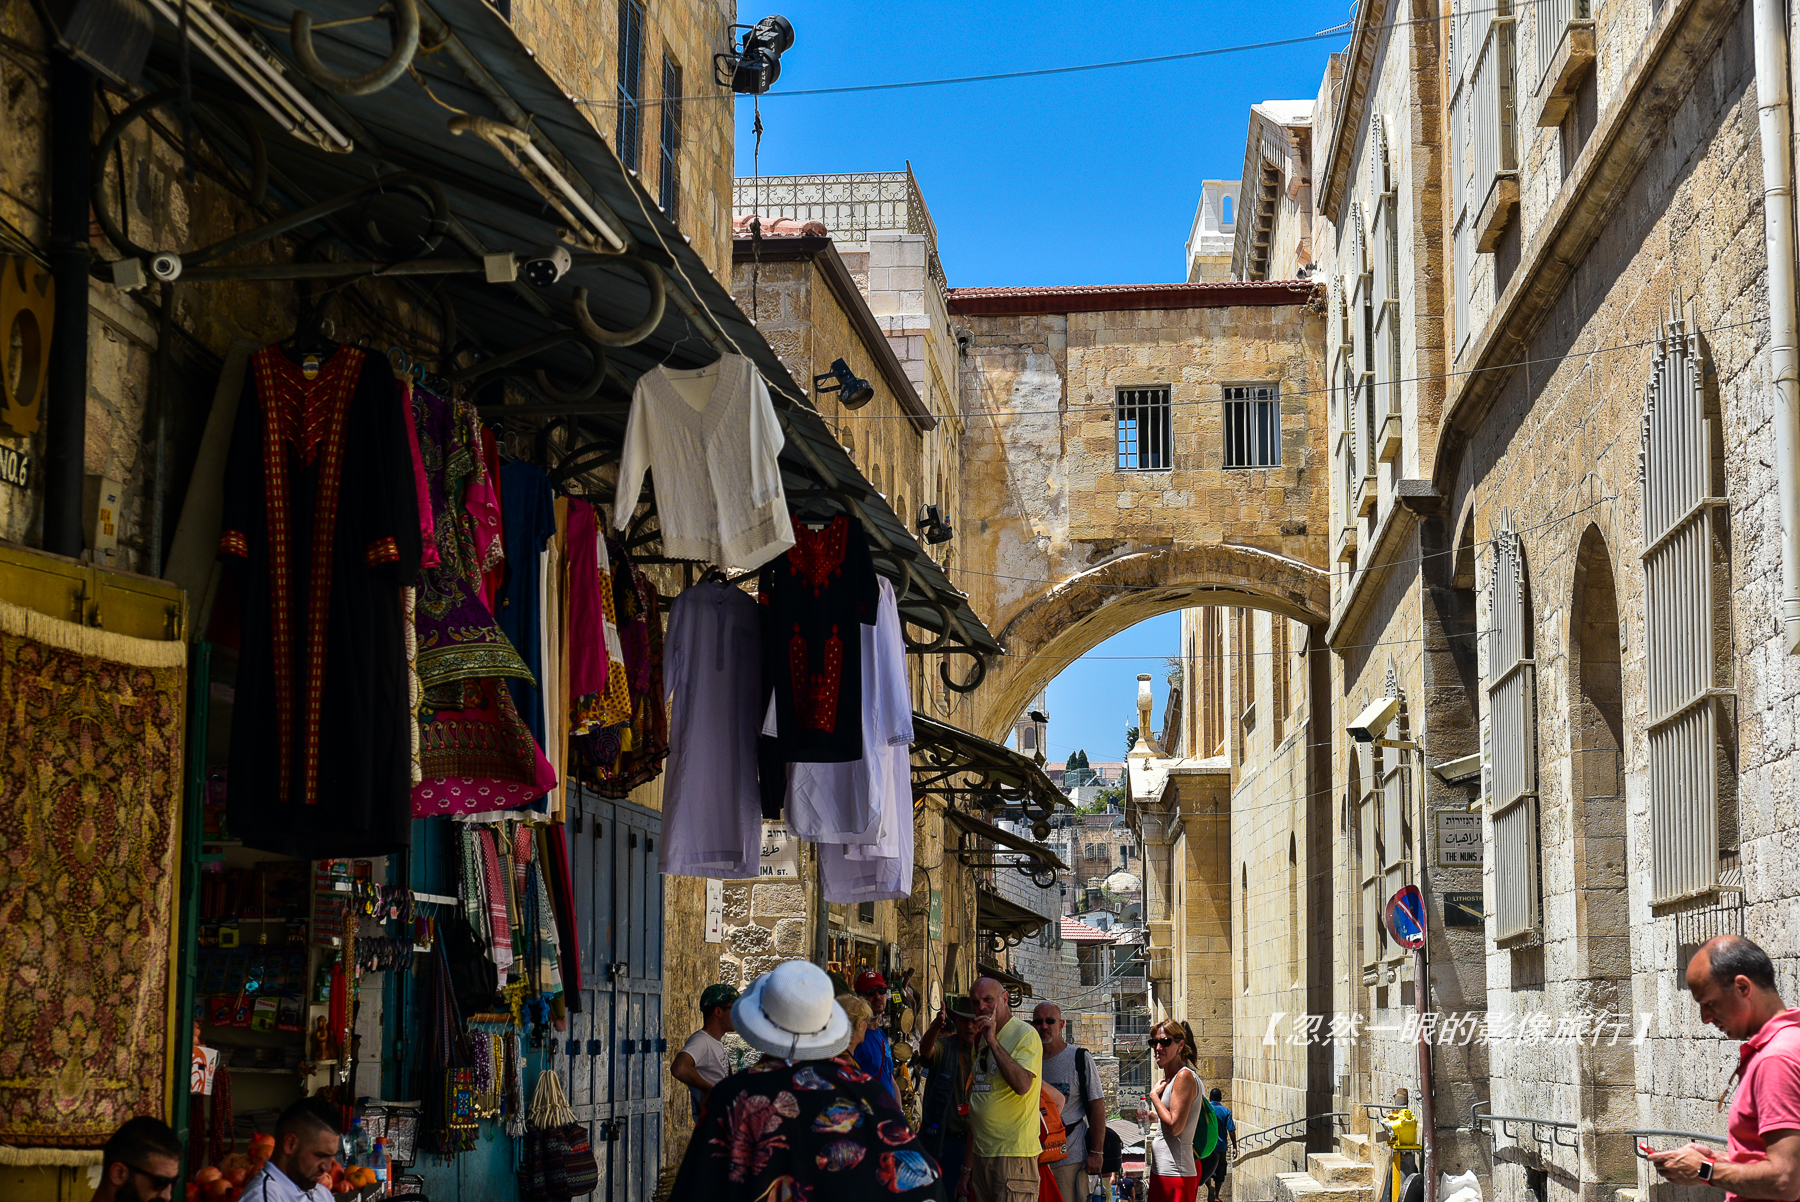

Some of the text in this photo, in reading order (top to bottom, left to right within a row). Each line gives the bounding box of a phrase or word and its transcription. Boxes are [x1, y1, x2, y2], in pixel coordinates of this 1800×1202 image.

[1445, 852, 1458, 862] THE
[1460, 852, 1478, 862] NUNS
[777, 868, 788, 876] ST.
[257, 1000, 276, 1008] TOSHIBA
[278, 1023, 298, 1032] SanDisk
